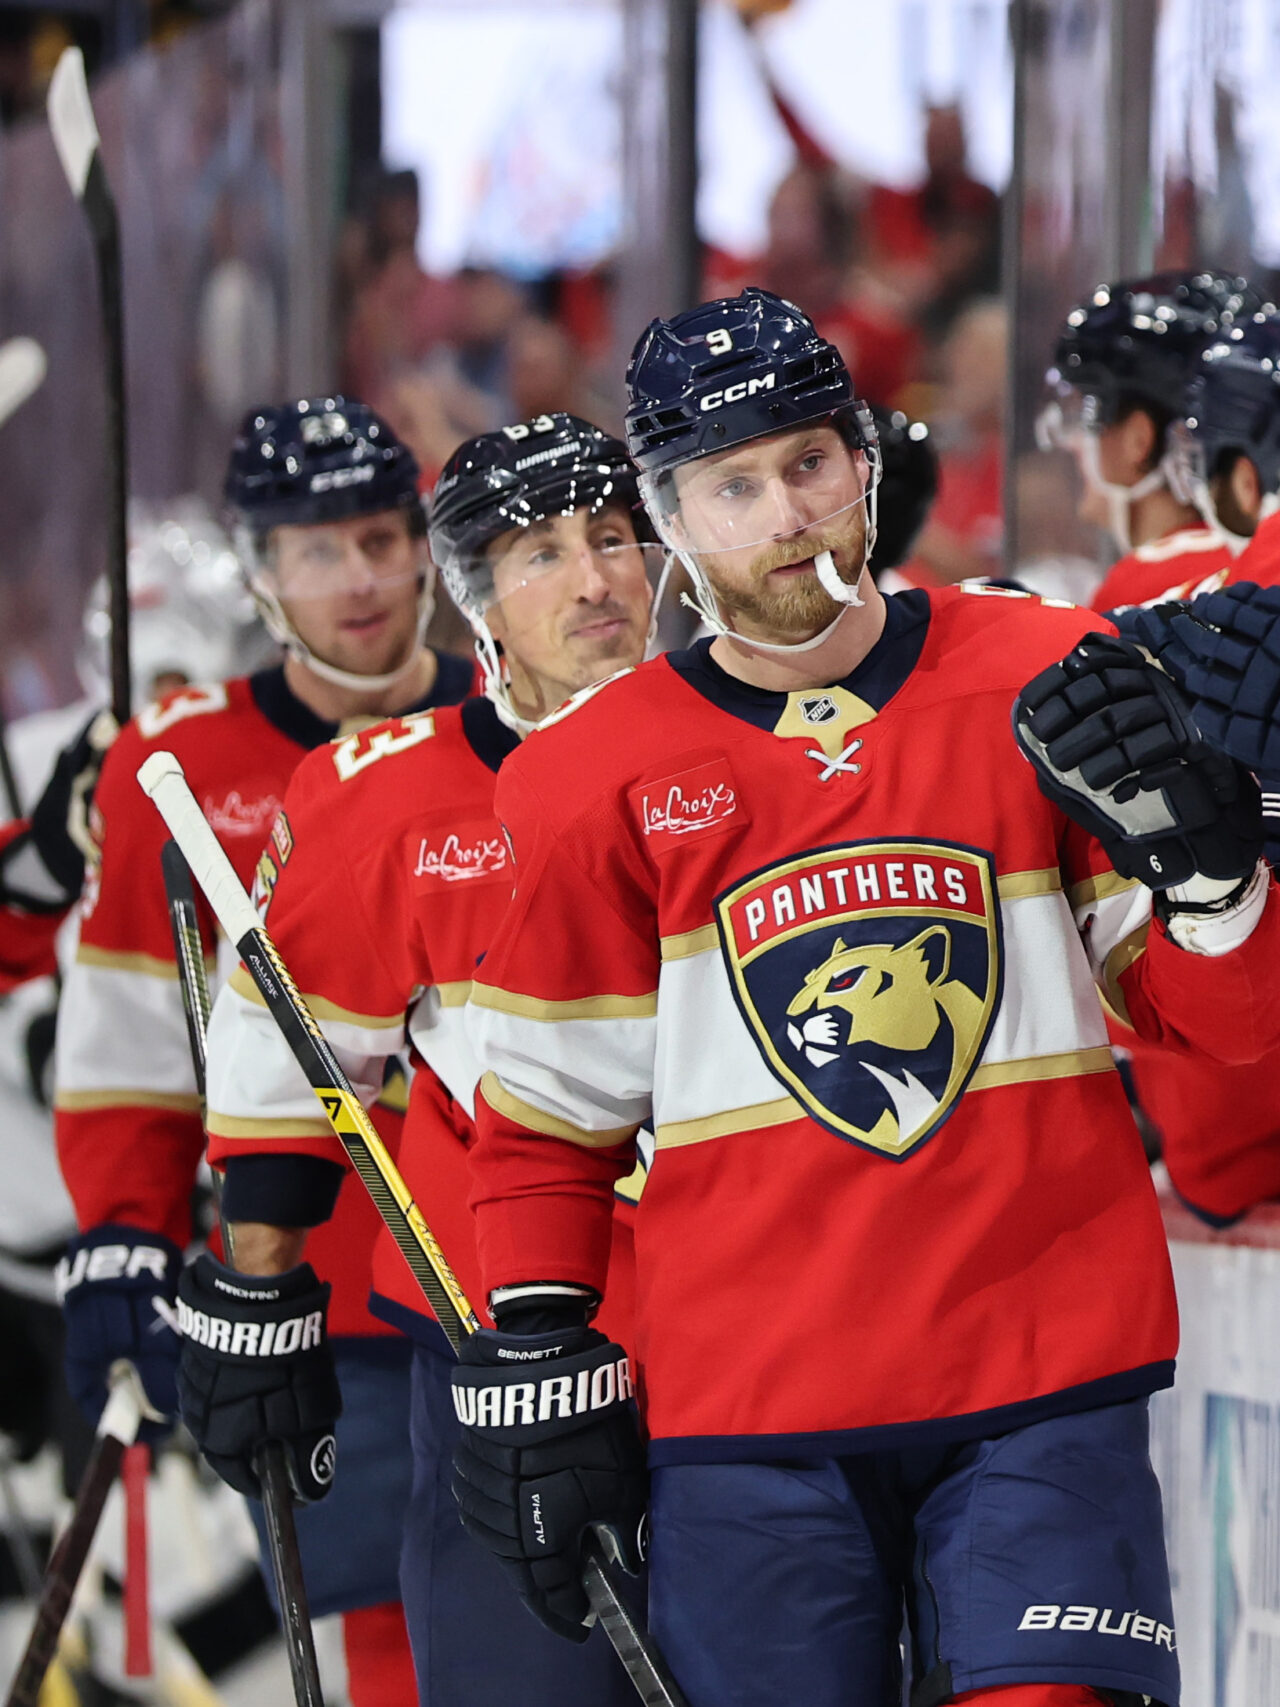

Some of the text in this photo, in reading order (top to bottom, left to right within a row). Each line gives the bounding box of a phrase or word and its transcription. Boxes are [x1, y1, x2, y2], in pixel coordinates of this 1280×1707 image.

[706, 328, 733, 356] 9
[700, 372, 776, 412] CCM
[515, 441, 581, 471] WARRIOR
[809, 701, 830, 721] NHL
[643, 783, 737, 836] LaCroix
[414, 834, 506, 881] LaCroix
[745, 862, 967, 941] PANTHERS
[175, 1296, 323, 1356] WARRIOR
[497, 1345, 564, 1360] BENNETT
[451, 1358, 634, 1427] WARRIOR
[531, 1493, 546, 1545] ALPHA
